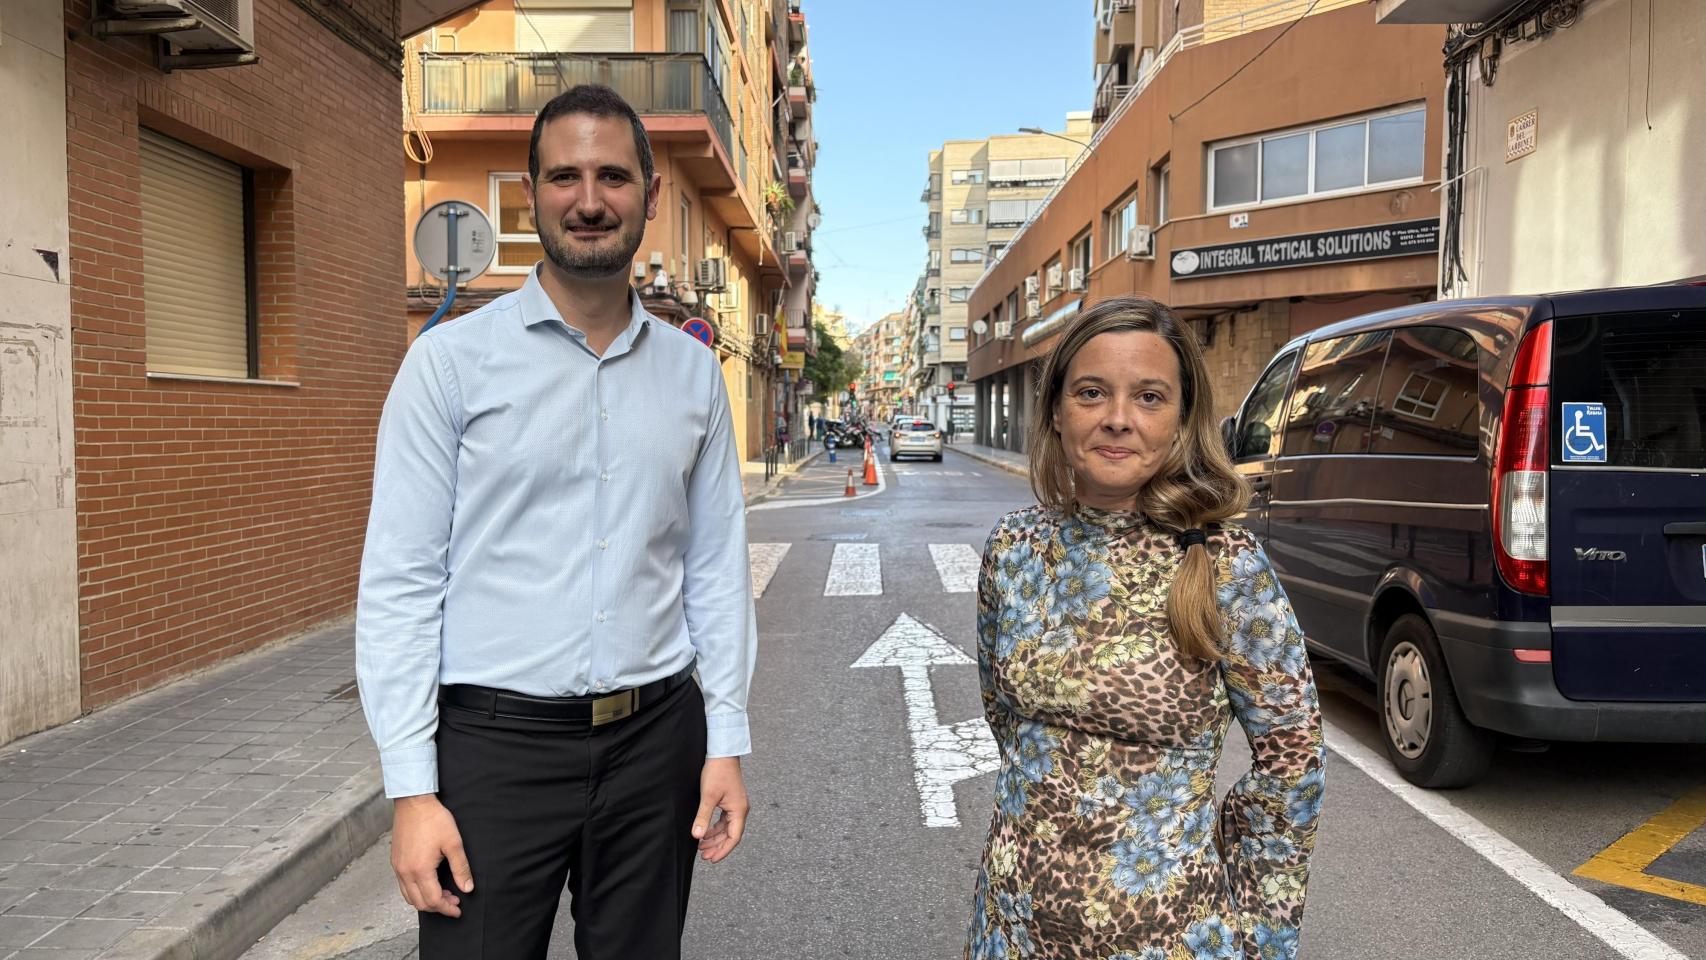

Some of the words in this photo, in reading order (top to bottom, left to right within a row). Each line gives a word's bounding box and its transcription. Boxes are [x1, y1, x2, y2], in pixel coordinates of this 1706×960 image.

[1200, 246, 1255, 269] INTEGRAL
[1257, 239, 1314, 263] TACTICAL
[1317, 229, 1391, 257] SOLUTIONS
